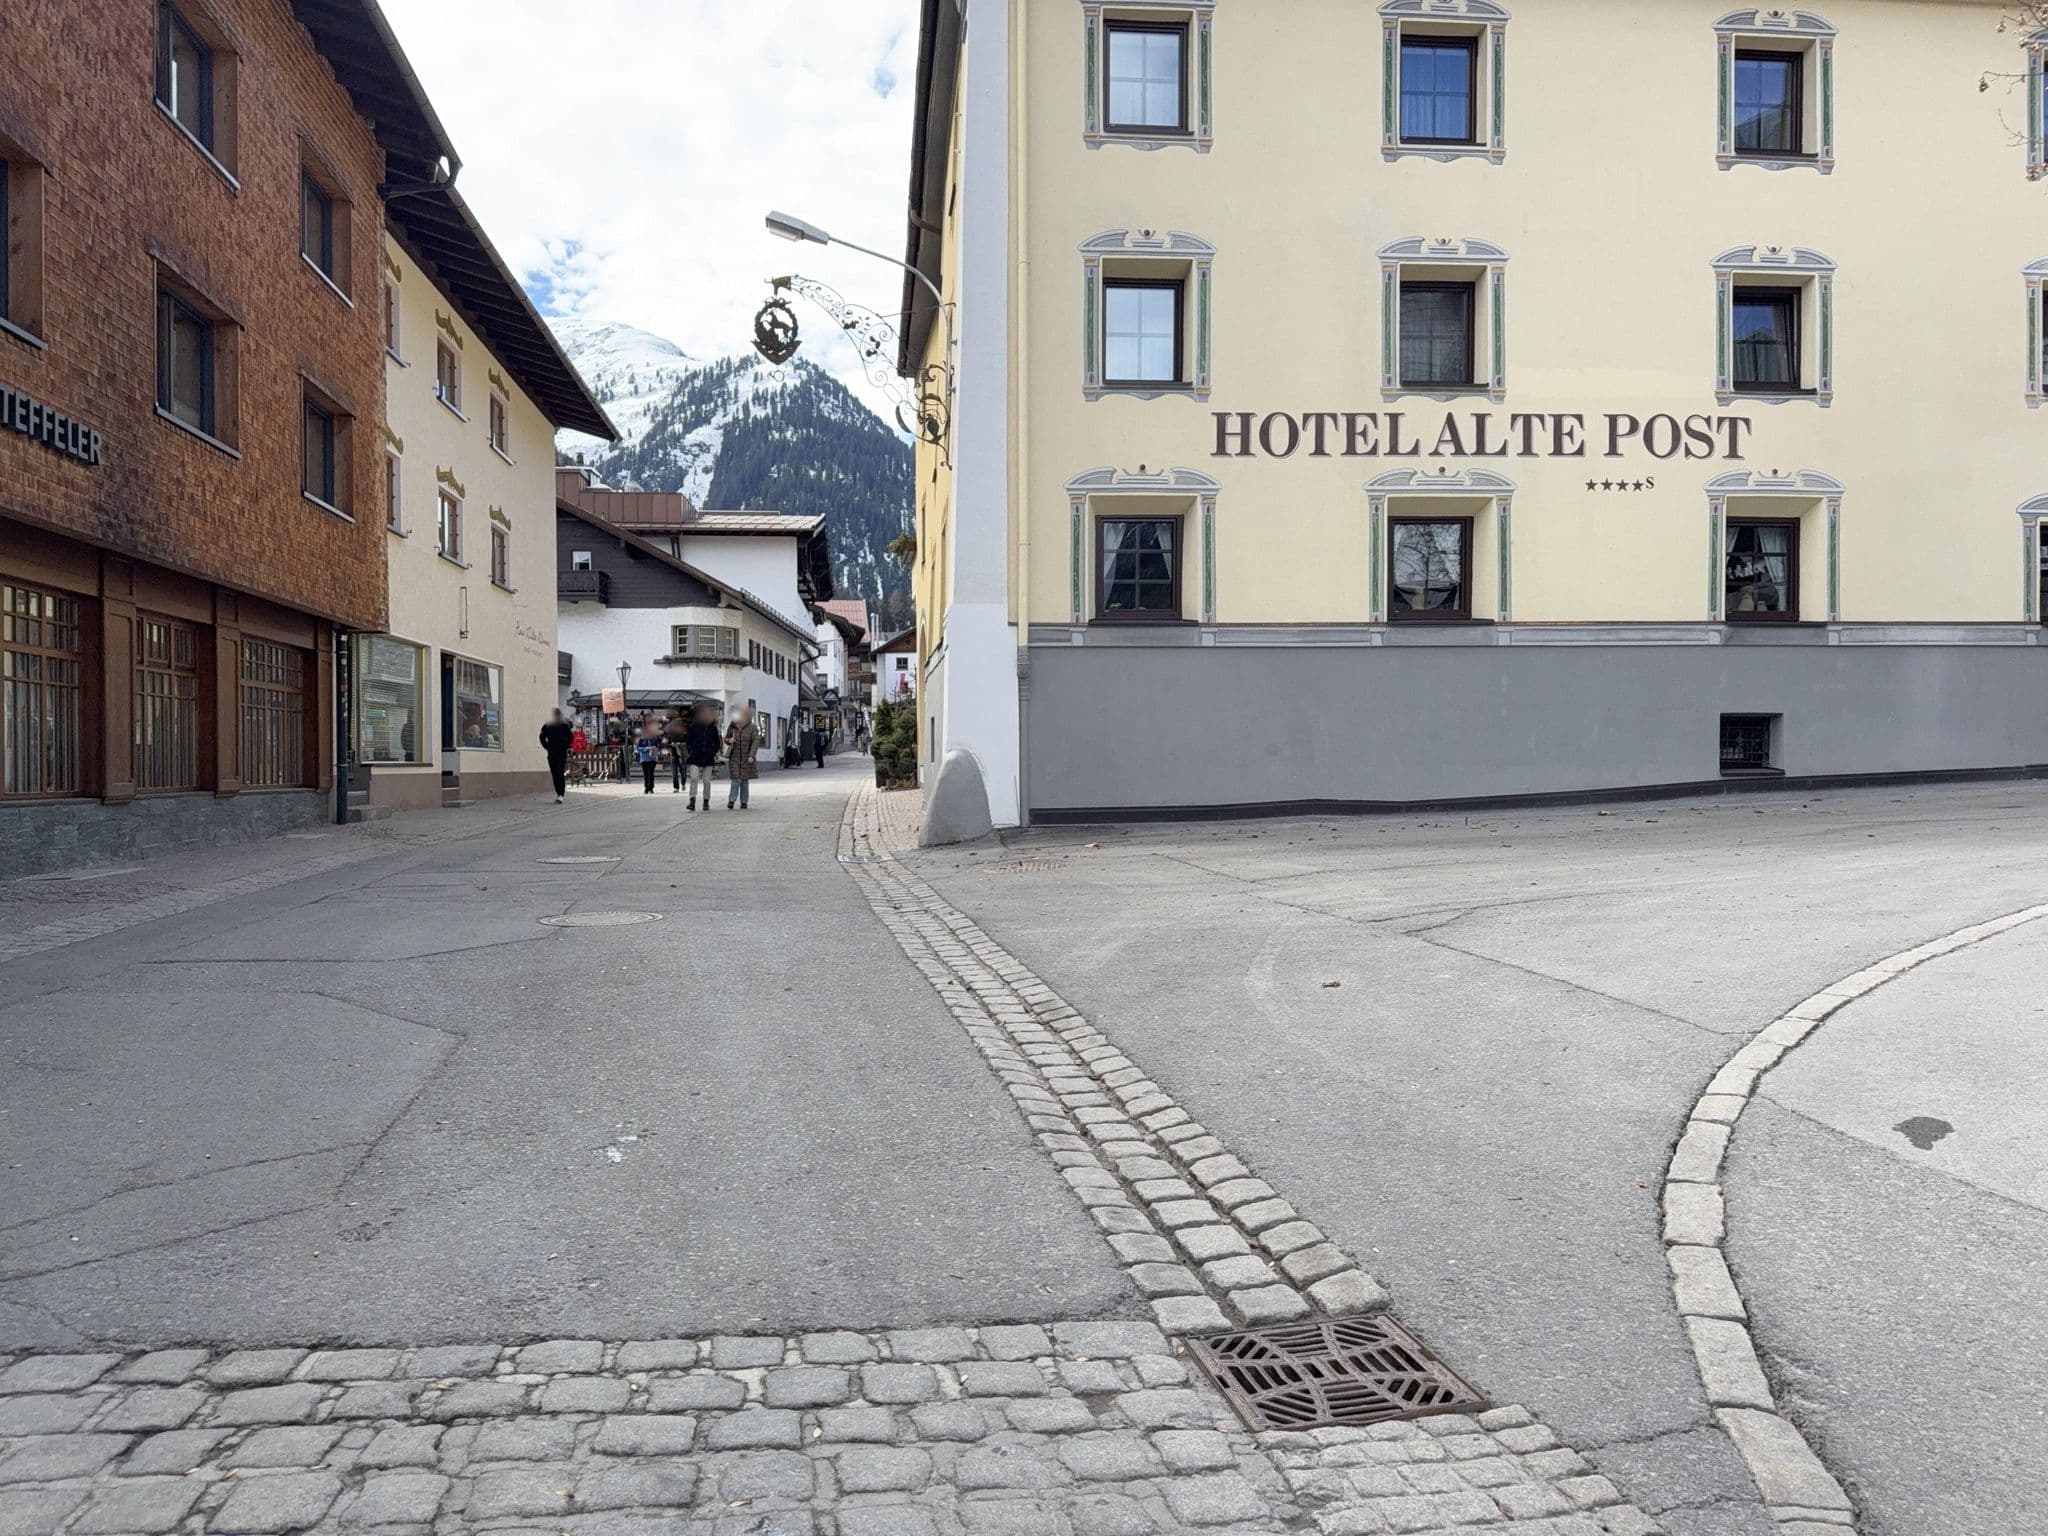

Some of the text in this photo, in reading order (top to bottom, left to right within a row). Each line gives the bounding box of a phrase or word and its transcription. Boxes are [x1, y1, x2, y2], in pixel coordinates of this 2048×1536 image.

[1210, 411, 1752, 460] HOTEL ALTE POST
